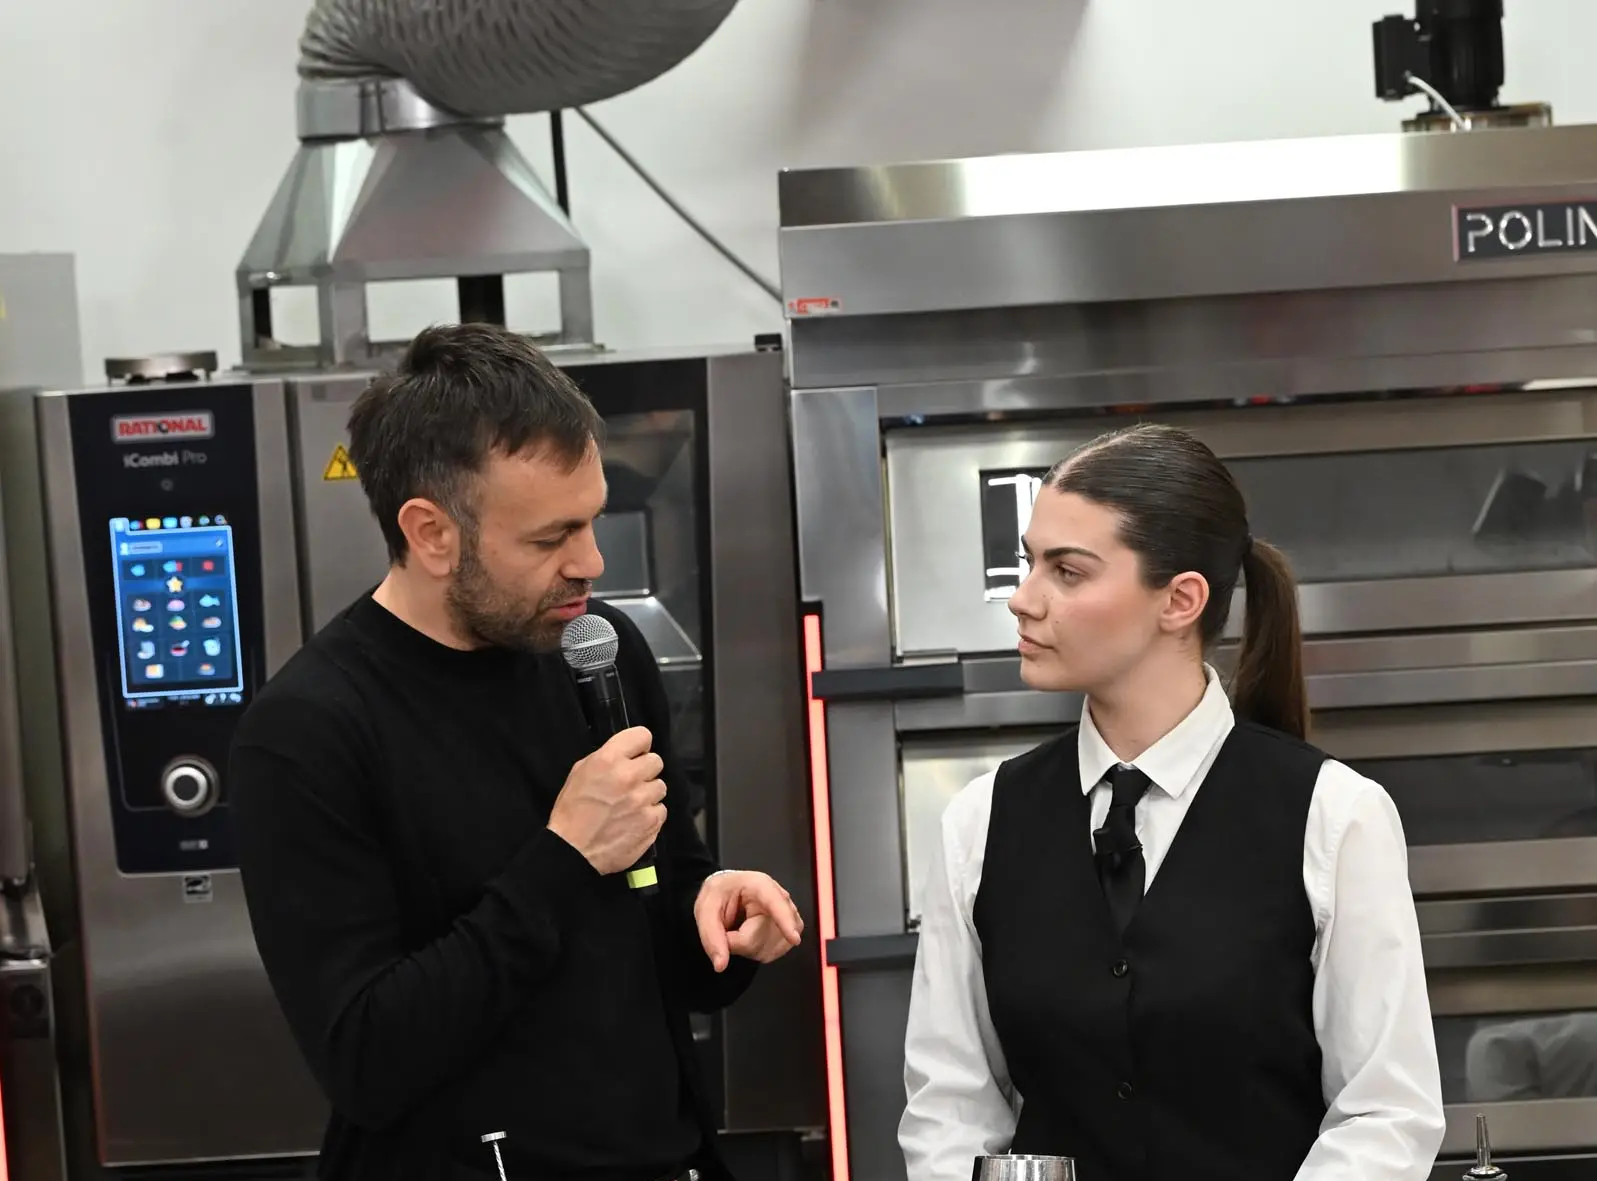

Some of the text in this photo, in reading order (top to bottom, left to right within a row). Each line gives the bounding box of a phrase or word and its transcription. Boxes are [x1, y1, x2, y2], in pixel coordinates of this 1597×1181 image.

[1466, 206, 1597, 253] POLIN
[119, 418, 207, 436] RATIONAL
[123, 450, 208, 469] iCombi Pro
